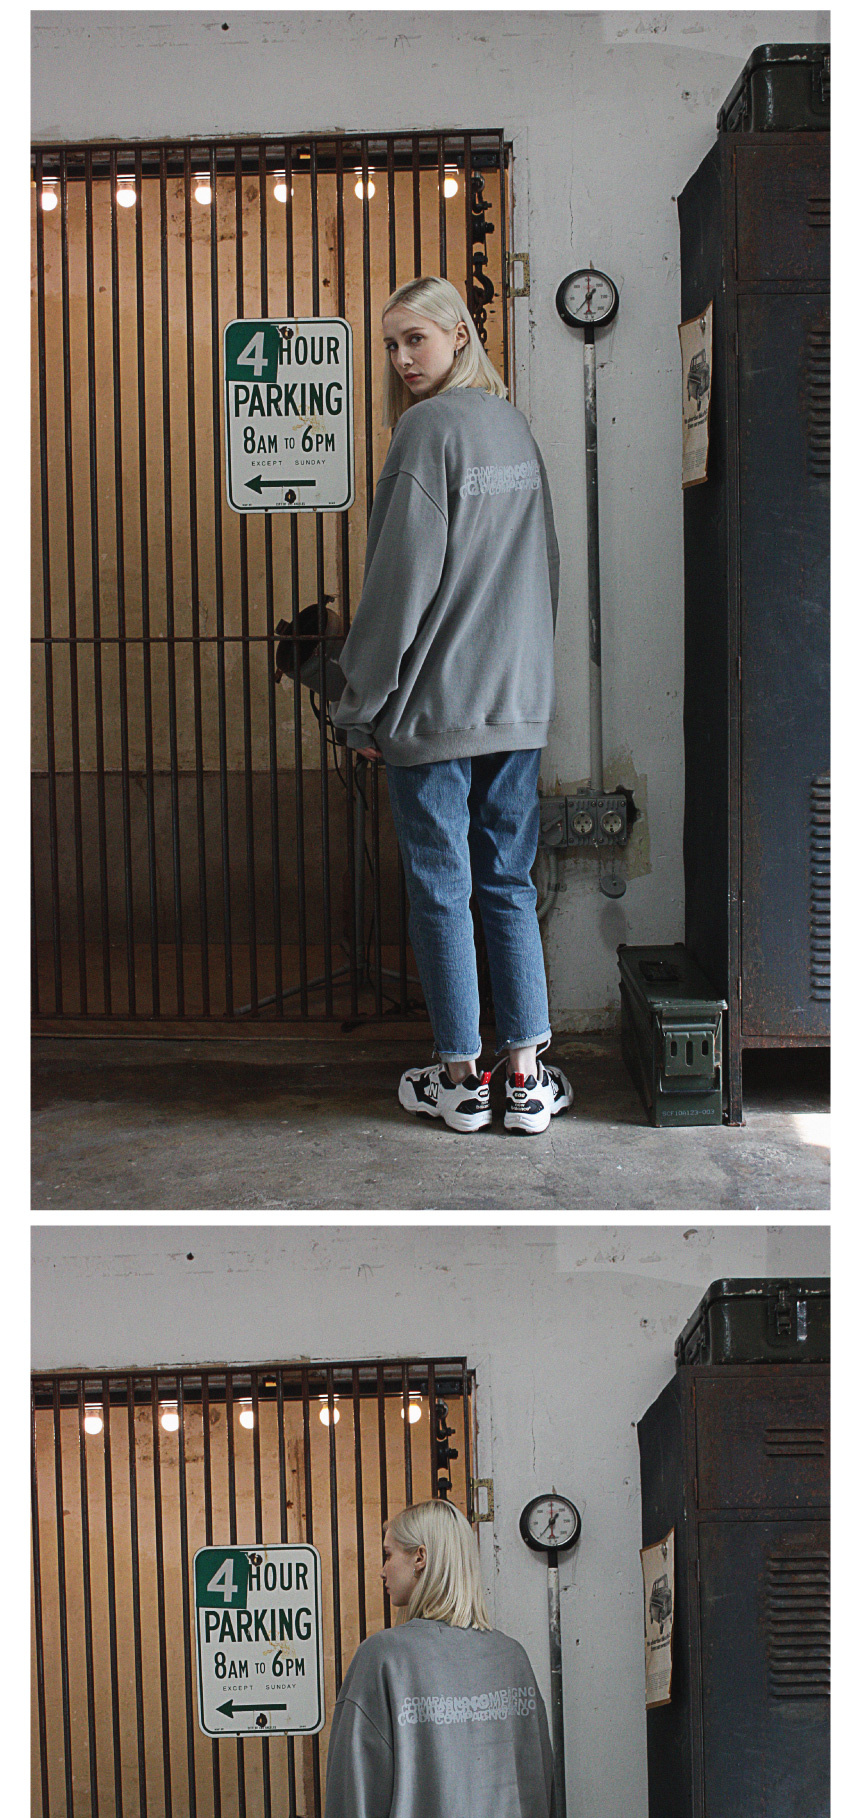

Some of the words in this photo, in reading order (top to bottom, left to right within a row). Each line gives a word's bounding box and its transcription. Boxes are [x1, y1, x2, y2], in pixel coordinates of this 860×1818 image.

[237, 331, 269, 377] 4
[279, 336, 340, 365] HOUR
[234, 382, 343, 417] PARKING
[243, 426, 278, 454] 8AM
[284, 437, 296, 449] TO
[301, 425, 335, 453] 6PM
[206, 1558, 238, 1602] 4
[248, 1562, 308, 1591] HOUR
[204, 1607, 312, 1643] PARKING
[214, 1651, 249, 1679] 8AM
[255, 1662, 266, 1674] TO
[271, 1650, 305, 1677] 6PM
